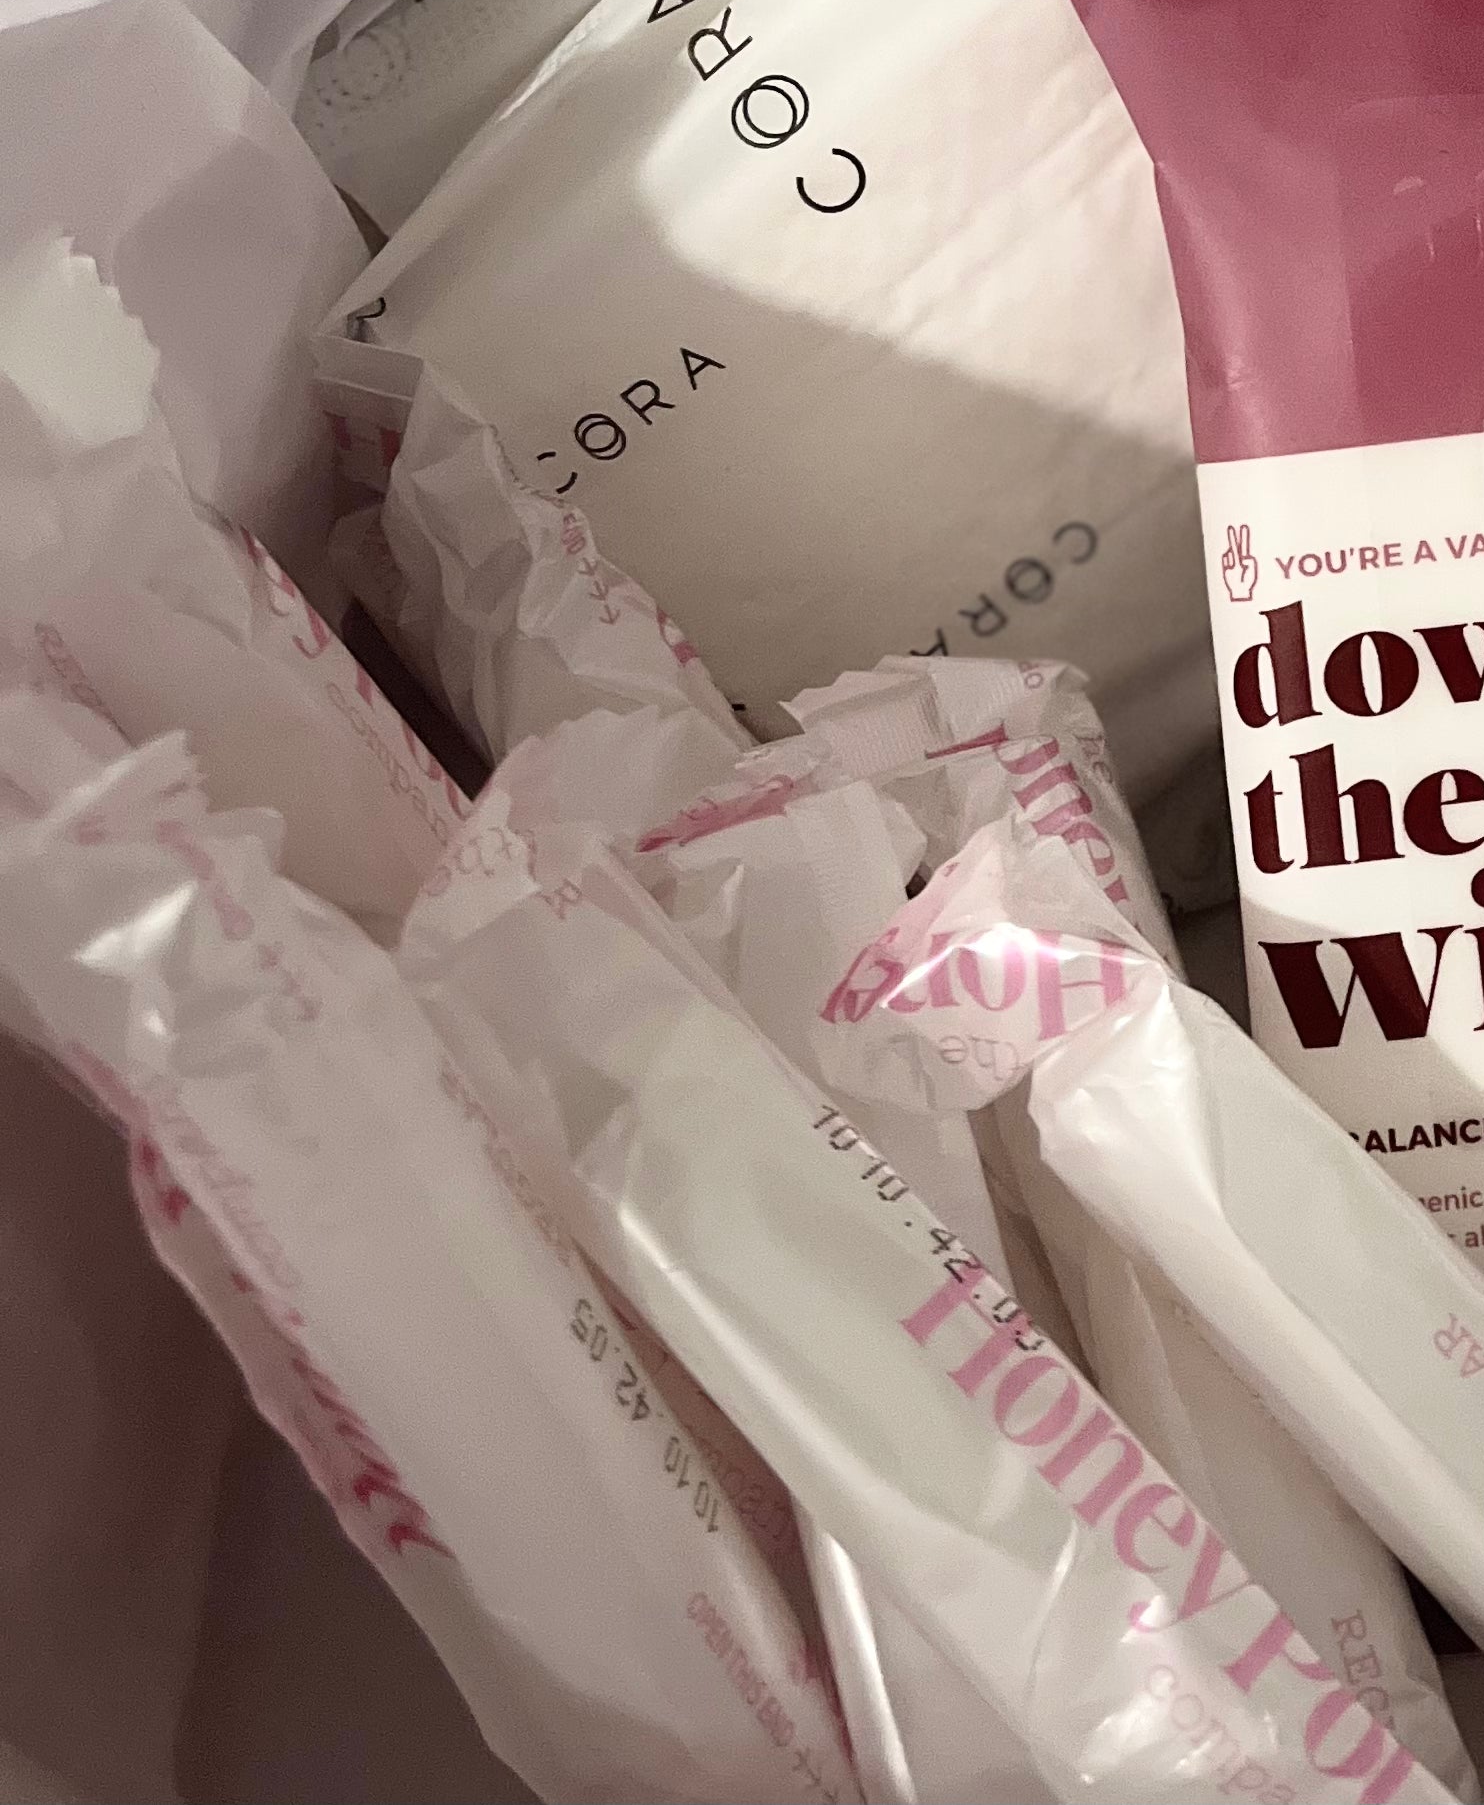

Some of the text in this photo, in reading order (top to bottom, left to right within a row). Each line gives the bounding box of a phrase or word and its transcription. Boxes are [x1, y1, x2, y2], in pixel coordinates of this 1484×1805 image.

[1275, 542, 1404, 580] YOU'RE
[1413, 540, 1438, 564] A
[1417, 1185, 1484, 1214] enic
